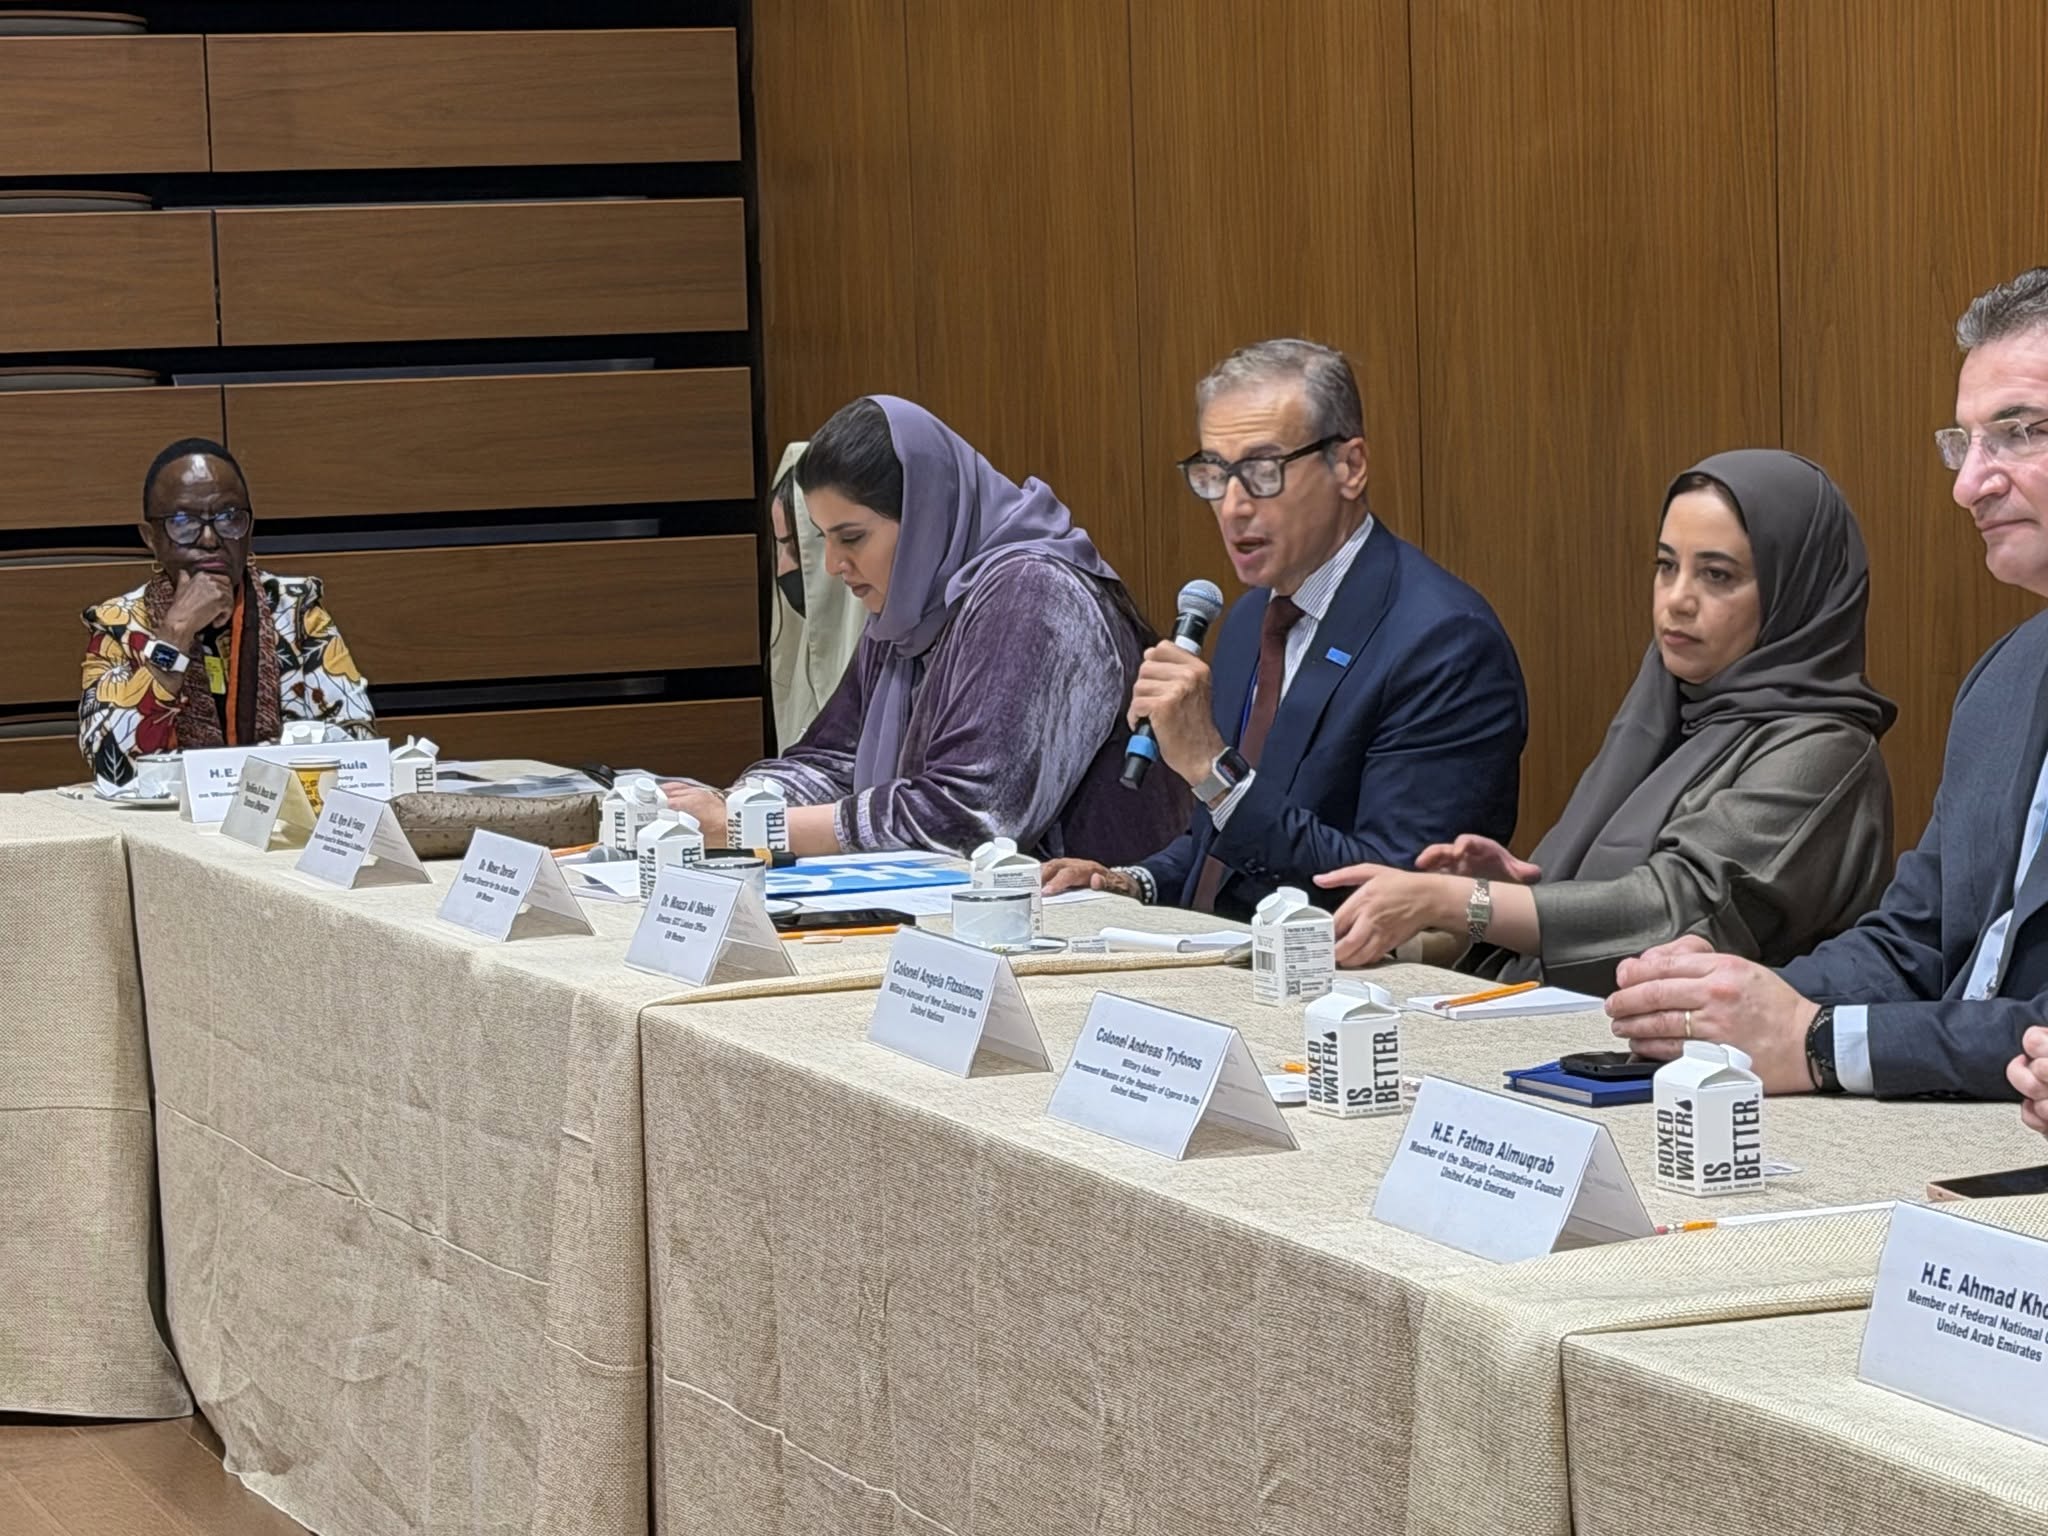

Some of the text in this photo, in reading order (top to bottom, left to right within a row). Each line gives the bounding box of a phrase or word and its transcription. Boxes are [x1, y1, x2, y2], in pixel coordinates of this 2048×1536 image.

[210, 768, 237, 778] H.E.
[615, 808, 626, 850] ETTER.
[766, 808, 786, 851] ETTER.
[661, 894, 669, 907] Dr.
[688, 900, 697, 912] Al
[889, 982, 907, 997] Military
[941, 999, 962, 1014] Zealand
[893, 960, 984, 1001] Colonel Angela Fitzsimons
[910, 1003, 945, 1023] United Nations
[1096, 1028, 1202, 1070] Colonel Andreas Tryfonos
[1122, 1059, 1140, 1073] Military
[1373, 1025, 1400, 1104] BETTER.
[1308, 1040, 1322, 1102] BOXED
[1321, 1039, 1339, 1105] WATER
[1110, 1085, 1148, 1103] United Nations
[1164, 1086, 1183, 1101] Cyprus
[1346, 1086, 1373, 1107] IS
[1430, 1121, 1555, 1175] H.E. Fatma Almuqrab
[1657, 1108, 1675, 1178] BOXED
[1675, 1111, 1695, 1181] WATER
[1732, 1093, 1761, 1181] BETTER.
[1408, 1140, 1565, 1199] Member of the Sharjah Consultative Council
[1440, 1165, 1517, 1200] United Arab Emirates
[1703, 1162, 1732, 1184] IS
[1921, 1261, 1953, 1292] H.E.
[1957, 1273, 2018, 1310] Ahmad
[1907, 1288, 1947, 1312] Member
[1948, 1302, 1960, 1316] of
[1960, 1305, 1999, 1329] Federal
[1999, 1316, 2044, 1341] National
[1937, 1317, 1970, 1340] United
[1969, 1328, 1995, 1347] Arab
[1996, 1335, 2043, 1362] Emirates
